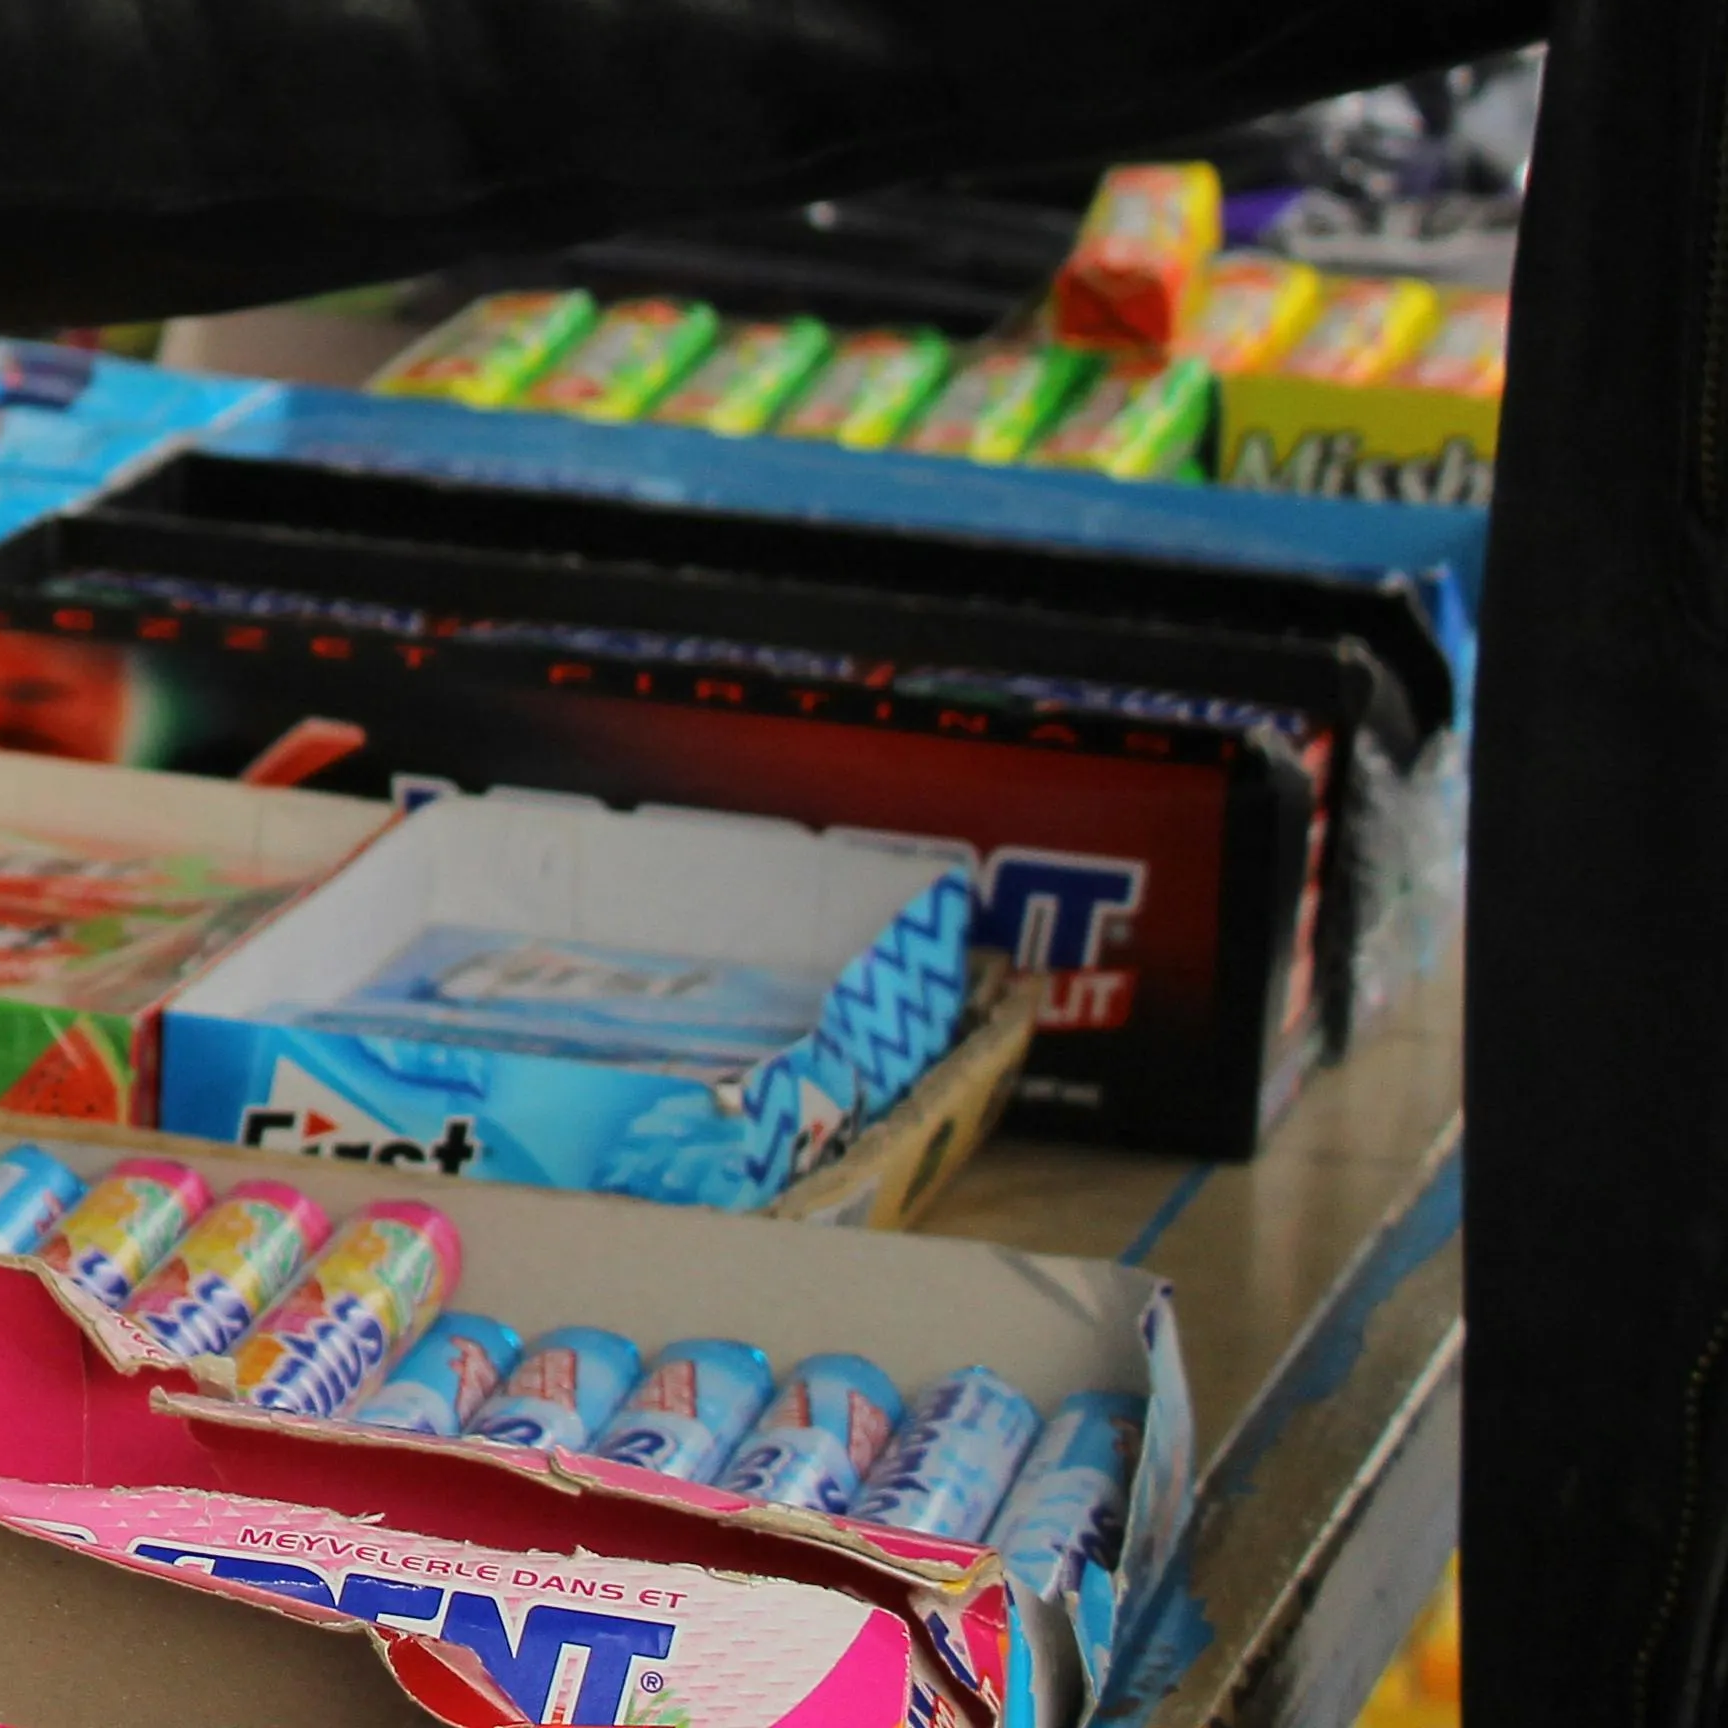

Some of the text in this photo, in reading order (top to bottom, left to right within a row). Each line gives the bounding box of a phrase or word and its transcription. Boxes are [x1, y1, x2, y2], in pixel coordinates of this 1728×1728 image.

[240, 1525, 688, 1610] MEYVELERLE DANS ET
